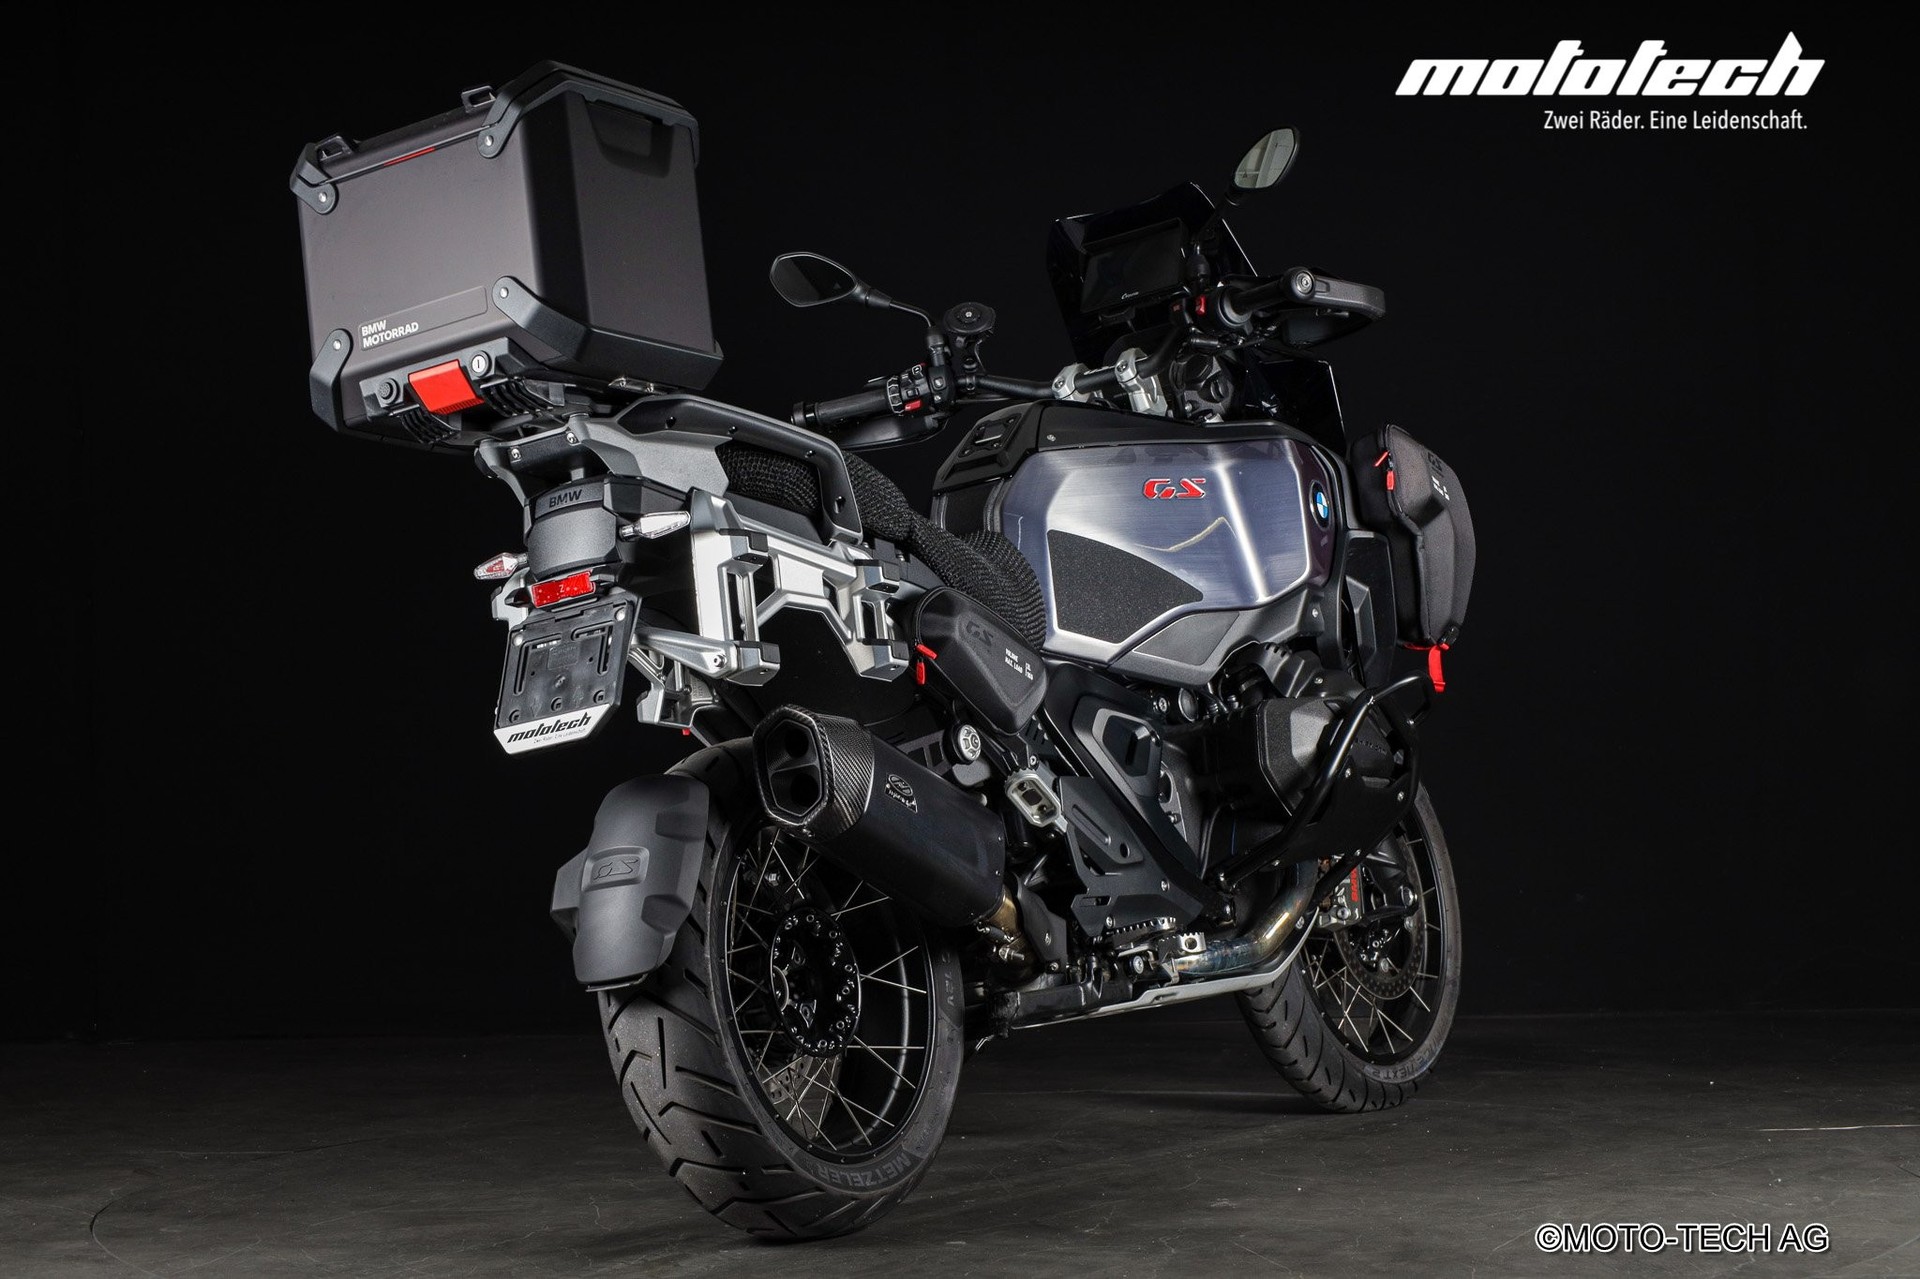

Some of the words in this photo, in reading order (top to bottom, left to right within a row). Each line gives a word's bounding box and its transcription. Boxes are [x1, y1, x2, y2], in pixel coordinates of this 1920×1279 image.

[361, 319, 387, 337] BMW
[362, 321, 419, 348] MOTORRAD
[549, 489, 582, 508] BMW
[1143, 478, 1206, 499] GS
[507, 711, 592, 743] mototech
[817, 1151, 913, 1188] METZELER
